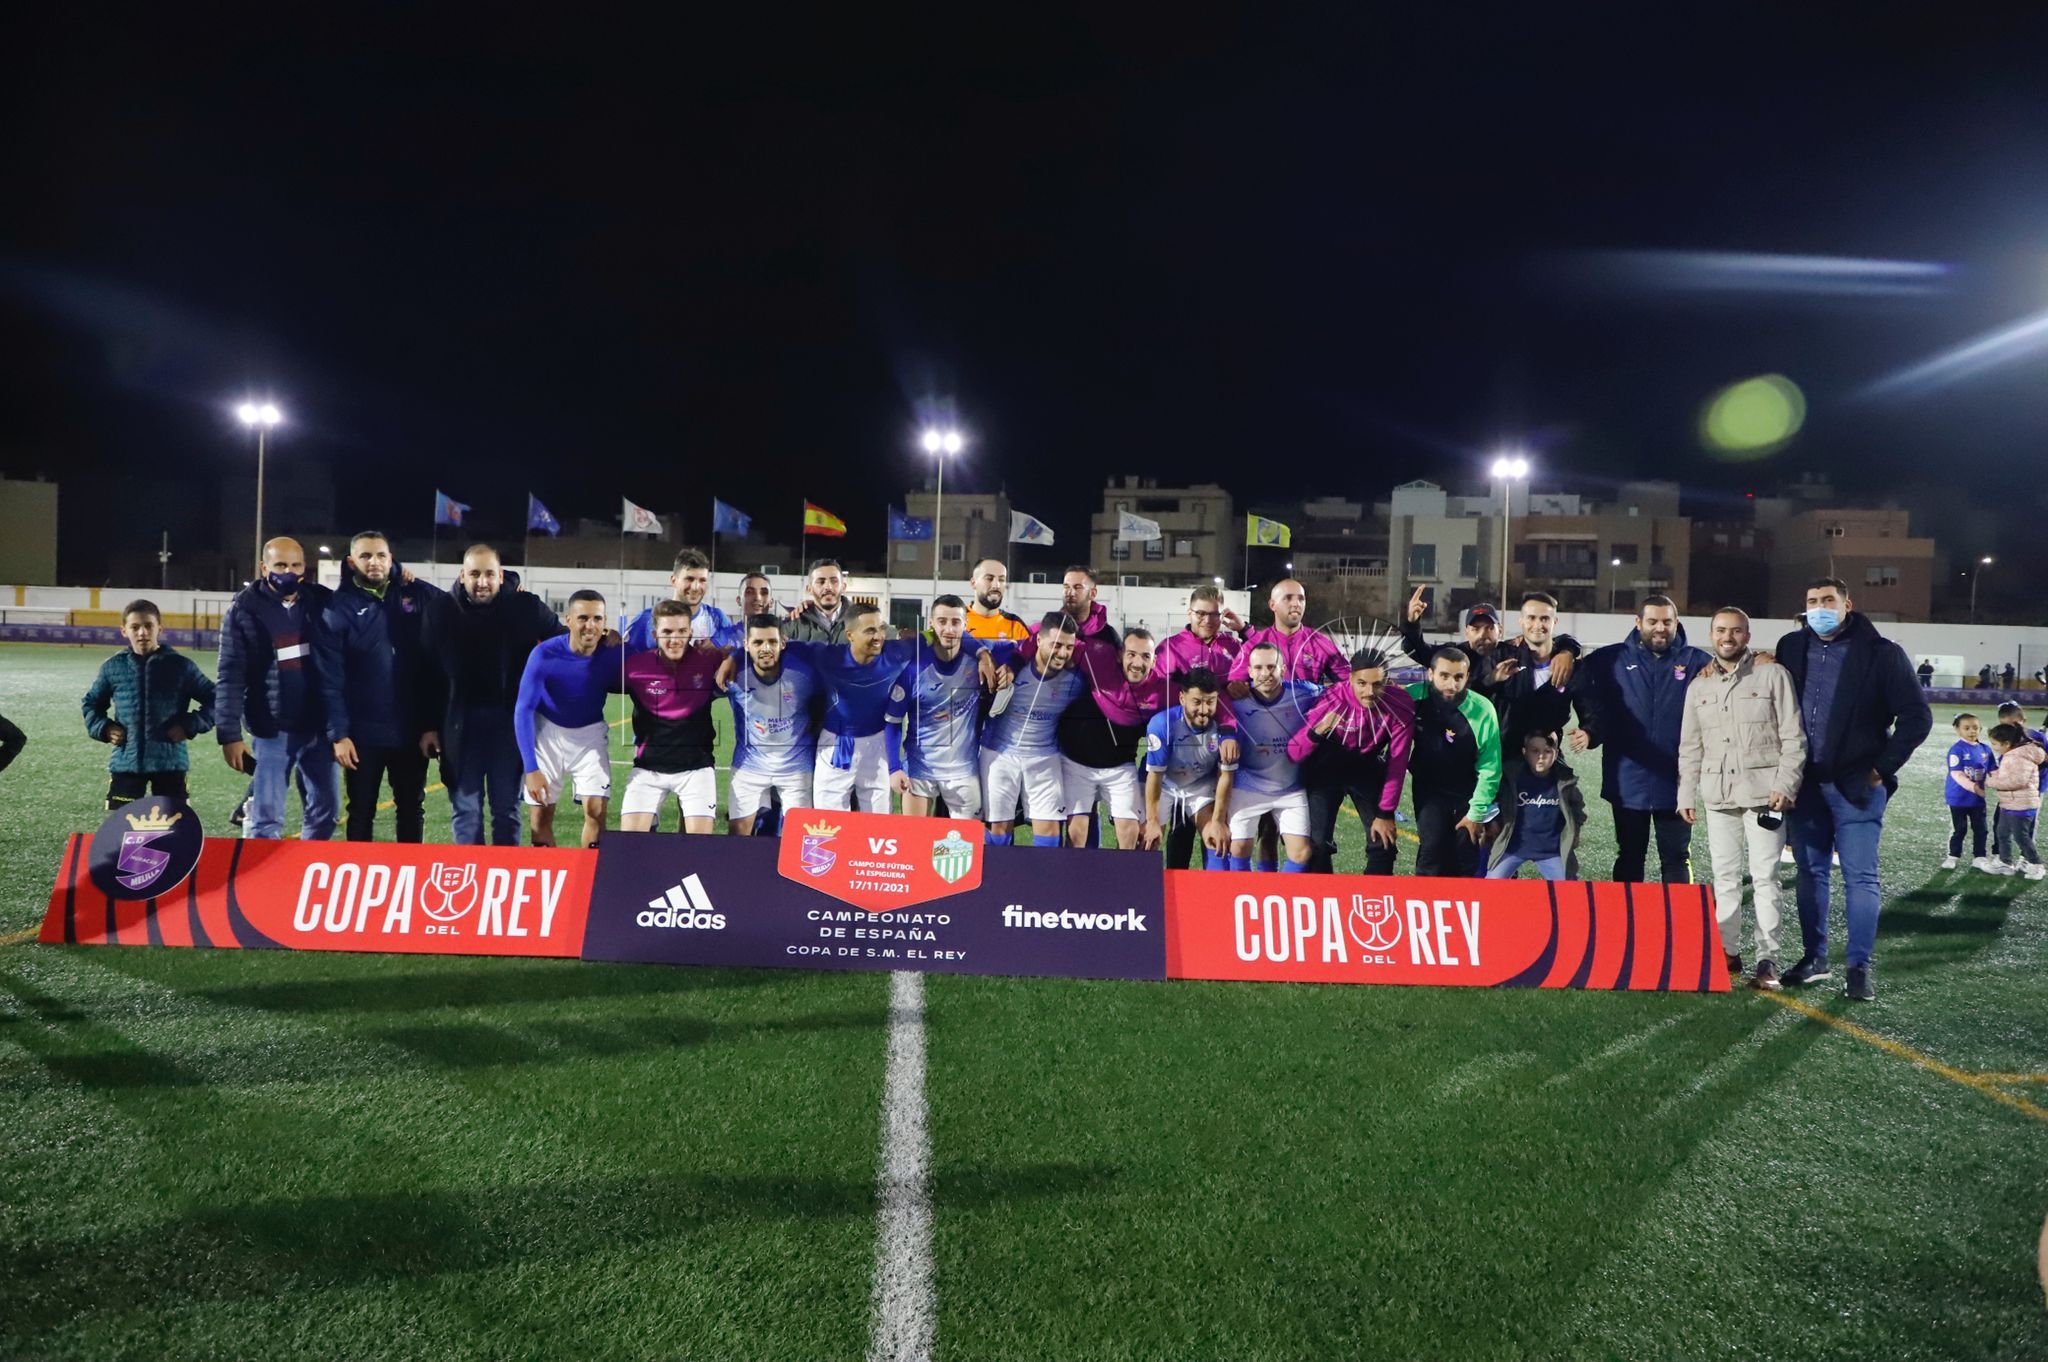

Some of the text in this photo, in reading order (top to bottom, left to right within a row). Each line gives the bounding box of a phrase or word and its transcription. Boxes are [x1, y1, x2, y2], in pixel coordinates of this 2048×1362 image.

[1517, 791, 1560, 808] Scalpers
[868, 837, 898, 856] VS
[848, 860, 875, 868] CAMPO
[887, 862, 915, 871] FÚTBOL
[130, 869, 160, 886] MELILLA
[866, 870, 905, 879] ESPIGUERA
[849, 880, 910, 893] 17/11/2021
[293, 862, 568, 937] COPA REY
[636, 908, 727, 930] adidas
[807, 910, 951, 925] CAMPEONATO
[1002, 904, 1148, 931] finetwork
[425, 925, 460, 935] DEL
[820, 927, 937, 941] DE ESPAÑA
[1234, 894, 1480, 966] COPA REY
[786, 946, 967, 960] COPA DE S.M. EL REY
[1362, 955, 1396, 964] DEL
